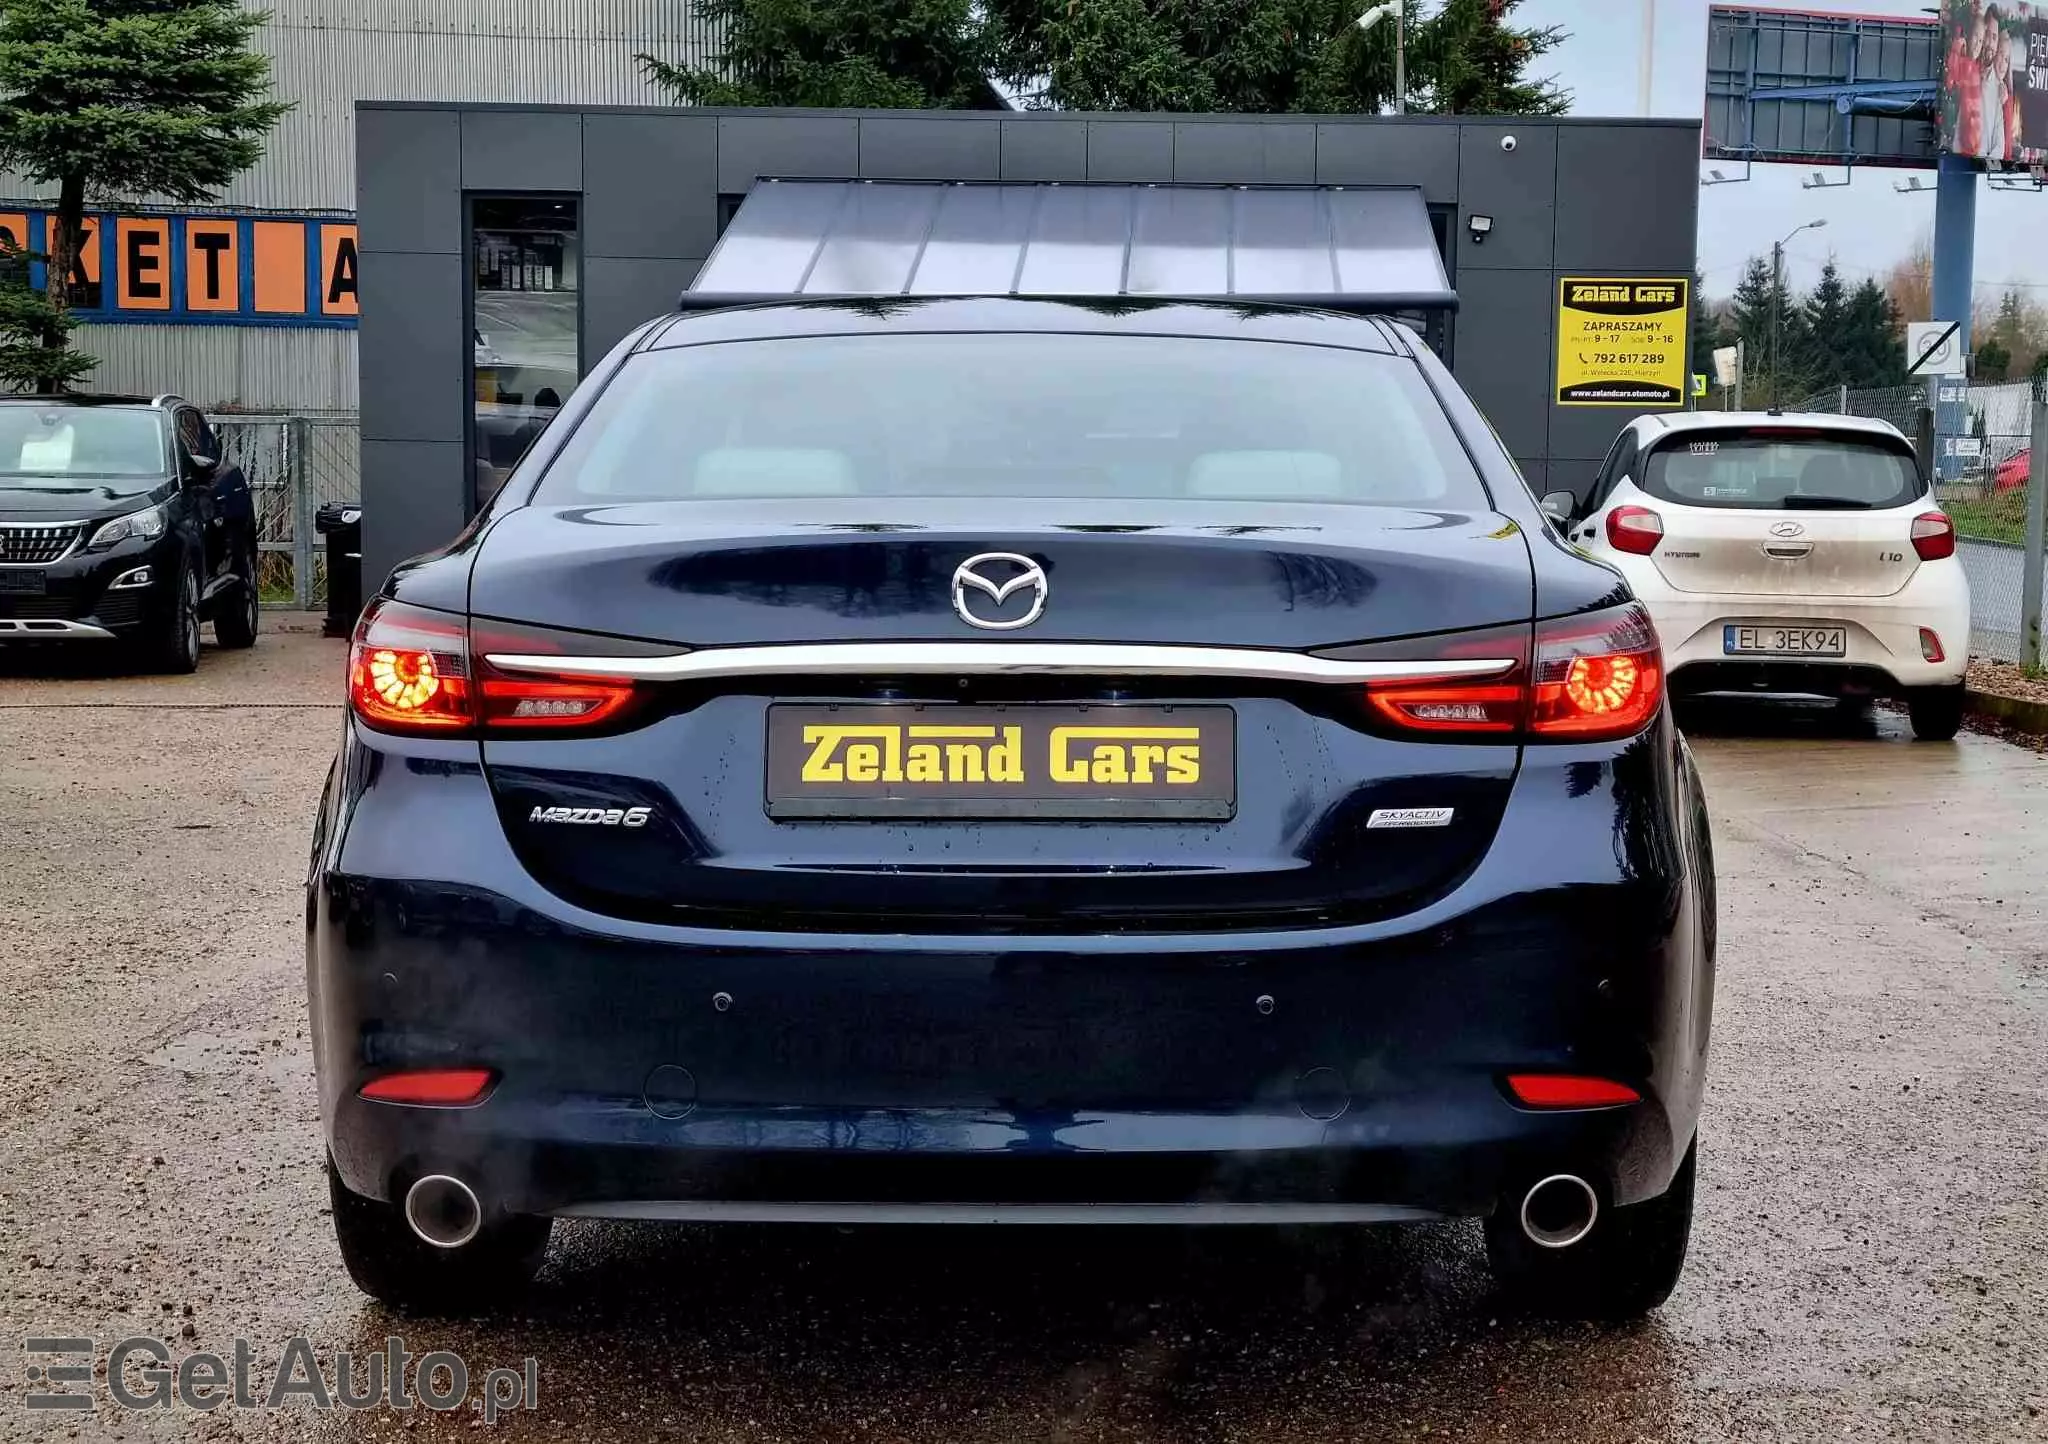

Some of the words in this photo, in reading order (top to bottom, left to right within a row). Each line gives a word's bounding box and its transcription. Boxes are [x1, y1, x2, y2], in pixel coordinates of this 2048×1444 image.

[1572, 285, 1630, 303] Zeland
[1635, 286, 1676, 303] Cars
[1583, 321, 1663, 331] ZAPRASZAMY
[1594, 335, 1601, 343] 9
[1610, 335, 1621, 343] 17
[1647, 335, 1654, 343] 9
[1663, 335, 1674, 343] 16
[1594, 353, 1615, 364] 792
[1619, 354, 1639, 364] 617
[1642, 354, 1665, 364] 289
[1570, 390, 1670, 399] www.zelandcars.otomoto.pl
[1740, 629, 1766, 649] EL
[1775, 630, 1840, 651] 3EK94
[801, 725, 1025, 783] Zeland
[1048, 726, 1201, 785] Cars
[1379, 810, 1446, 819] SKYACTIV
